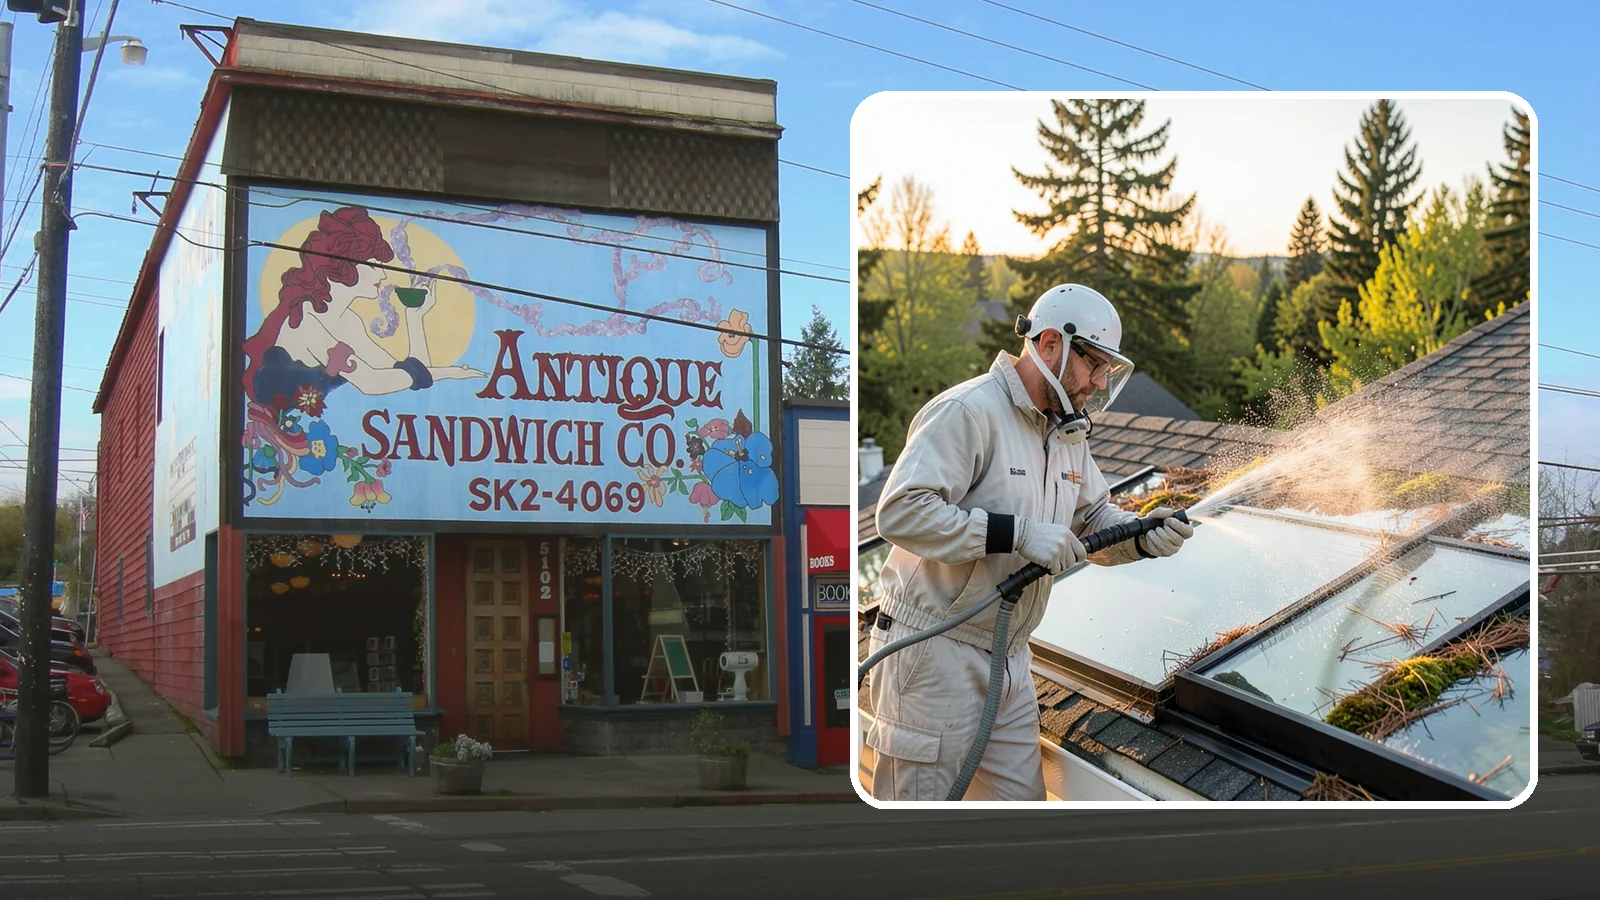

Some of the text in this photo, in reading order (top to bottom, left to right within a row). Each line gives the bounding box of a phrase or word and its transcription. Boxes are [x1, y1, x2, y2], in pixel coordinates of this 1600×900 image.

[476, 329, 724, 421] ANTIQUE
[361, 408, 684, 468] SANDWICH CO.
[468, 477, 646, 513] SK2-4069
[540, 541, 552, 600] 5102
[809, 555, 835, 569] BOOKS
